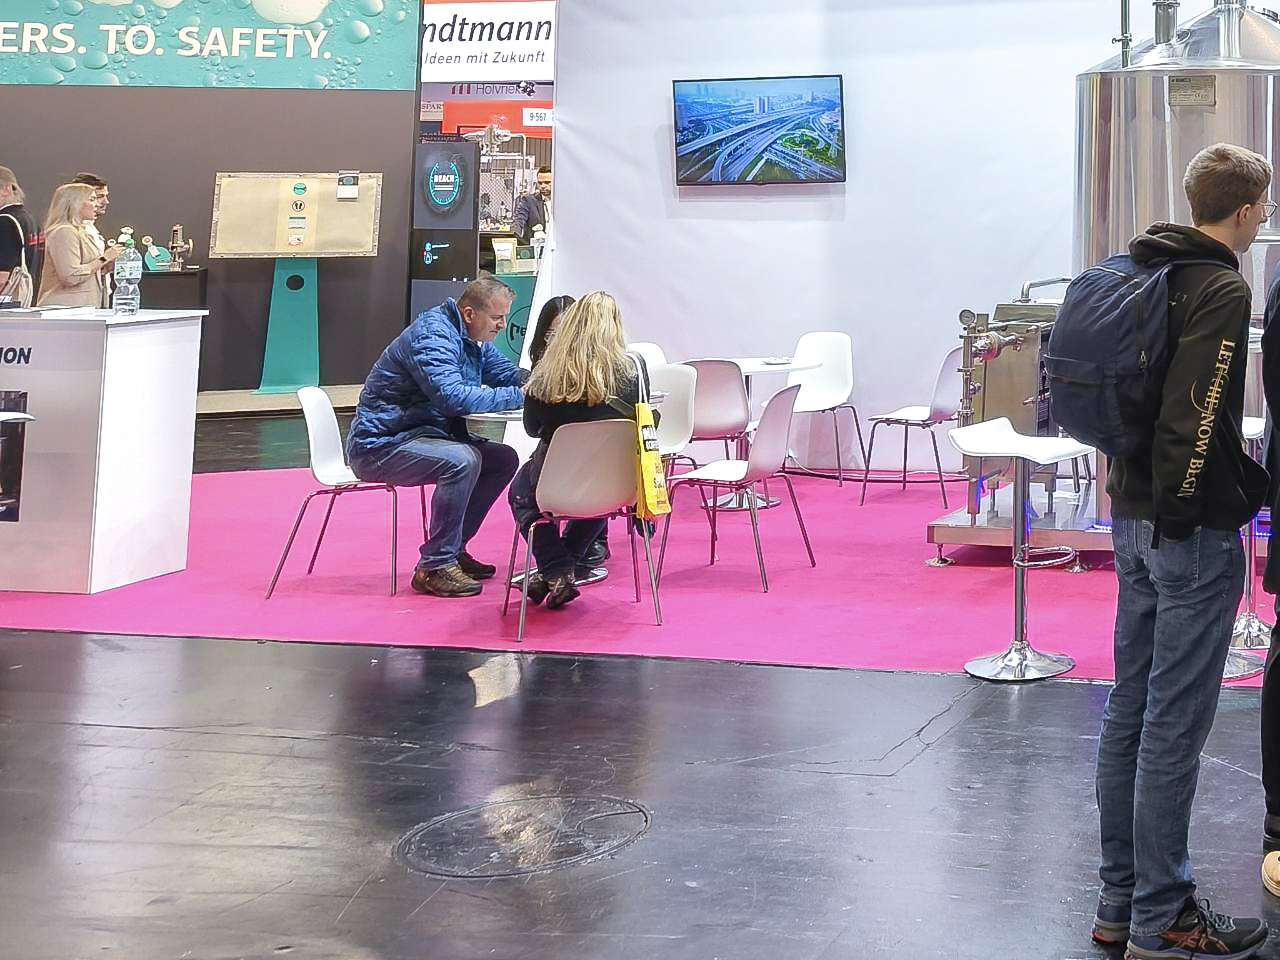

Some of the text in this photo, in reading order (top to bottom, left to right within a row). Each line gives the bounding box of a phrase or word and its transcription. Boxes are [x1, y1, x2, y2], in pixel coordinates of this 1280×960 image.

[0, 21, 332, 59] ERS. TO. SAFETY.
[424, 52, 461, 65] Ideen
[466, 52, 488, 64] mit
[1194, 412, 1216, 455] NOW
